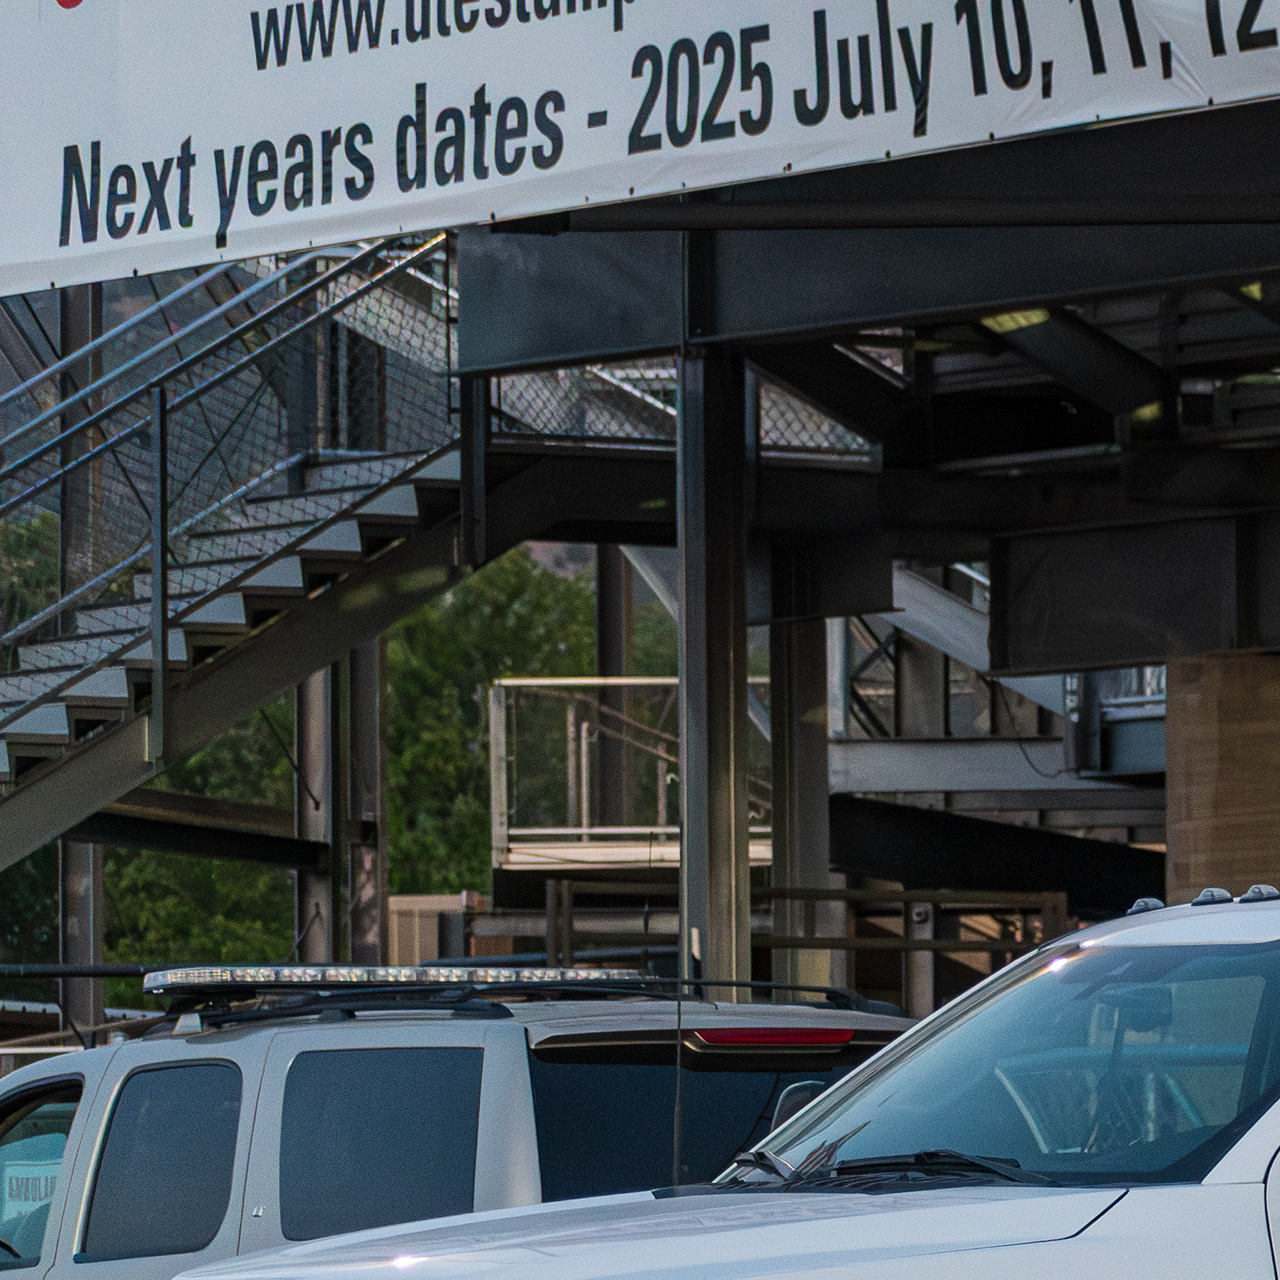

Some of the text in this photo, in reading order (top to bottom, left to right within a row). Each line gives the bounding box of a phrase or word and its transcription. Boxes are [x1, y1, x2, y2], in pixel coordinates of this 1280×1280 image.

[58, 135, 198, 248] Next
[213, 122, 376, 249] years
[395, 82, 566, 193] dates
[587, 110, 608, 129] -
[627, 23, 774, 155] 2025
[793, 0, 934, 138] July
[953, 0, 1055, 100] 10,
